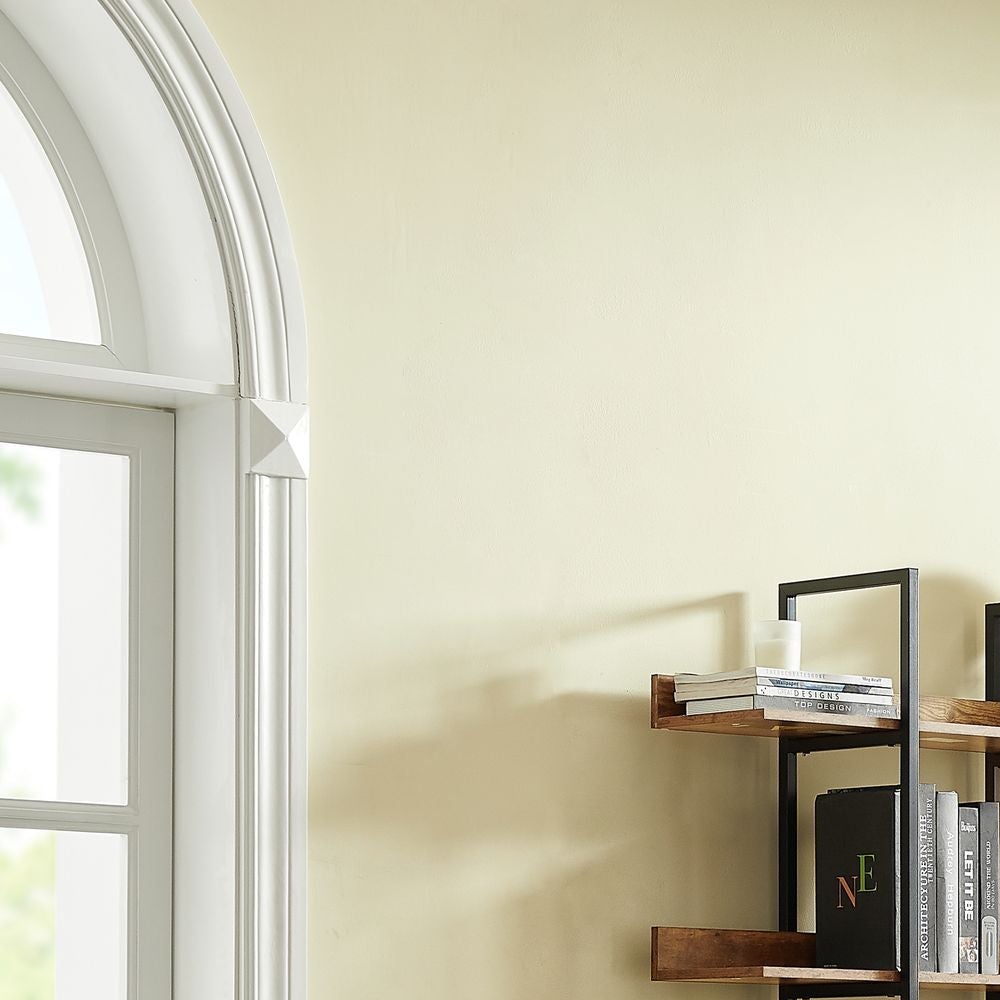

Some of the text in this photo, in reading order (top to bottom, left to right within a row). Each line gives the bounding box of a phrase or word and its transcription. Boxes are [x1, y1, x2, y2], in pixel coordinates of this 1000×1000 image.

[793, 690, 840, 700] DESIGNS
[794, 700, 852, 712] TOP DESIGN
[920, 814, 928, 841] THE
[920, 844, 928, 858] IN
[946, 831, 955, 936] Audrey Hepburn
[964, 850, 974, 921] LET IT BE
